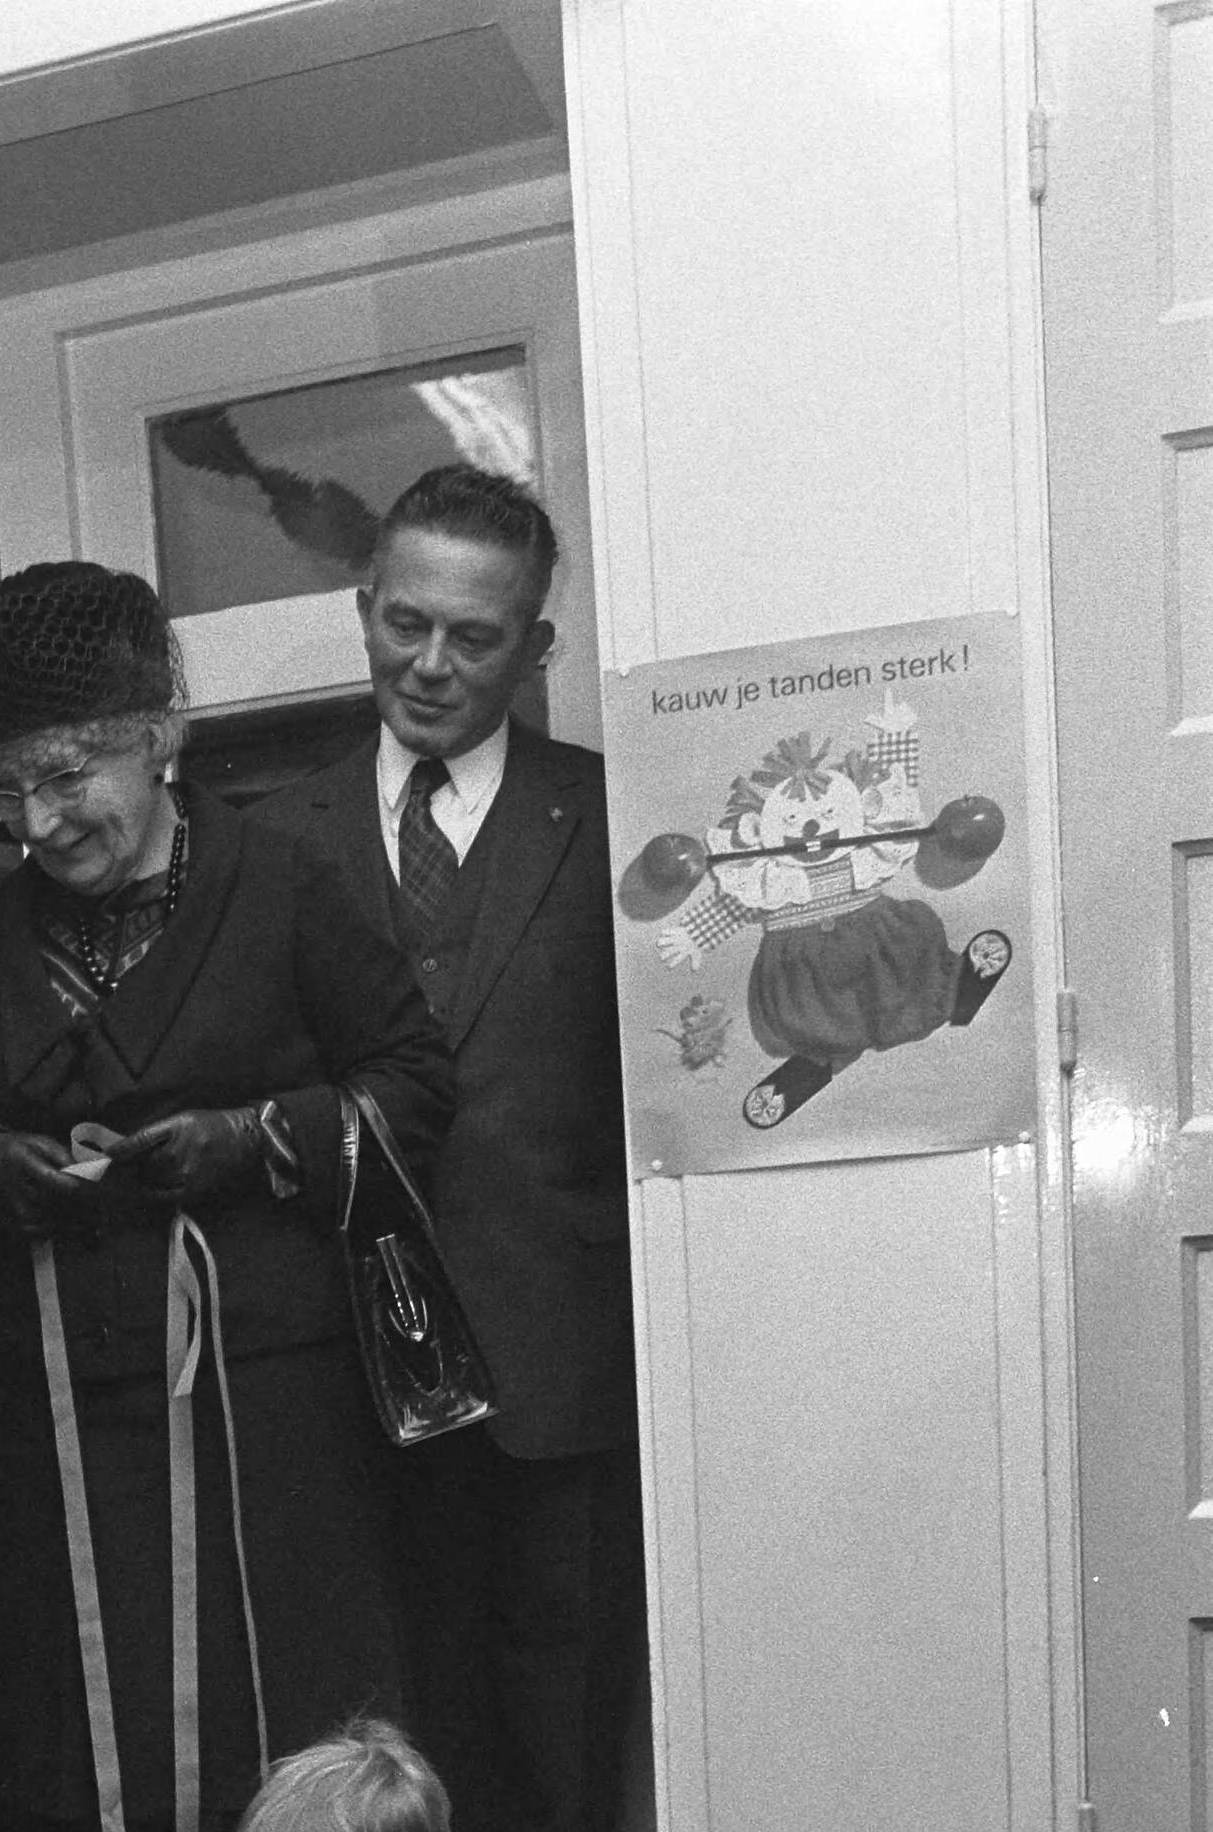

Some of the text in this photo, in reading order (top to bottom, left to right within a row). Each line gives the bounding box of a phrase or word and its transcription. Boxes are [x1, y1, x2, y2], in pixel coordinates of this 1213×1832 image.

[652, 686, 728, 714] kauw
[736, 678, 760, 709] je
[768, 664, 871, 698] tanden
